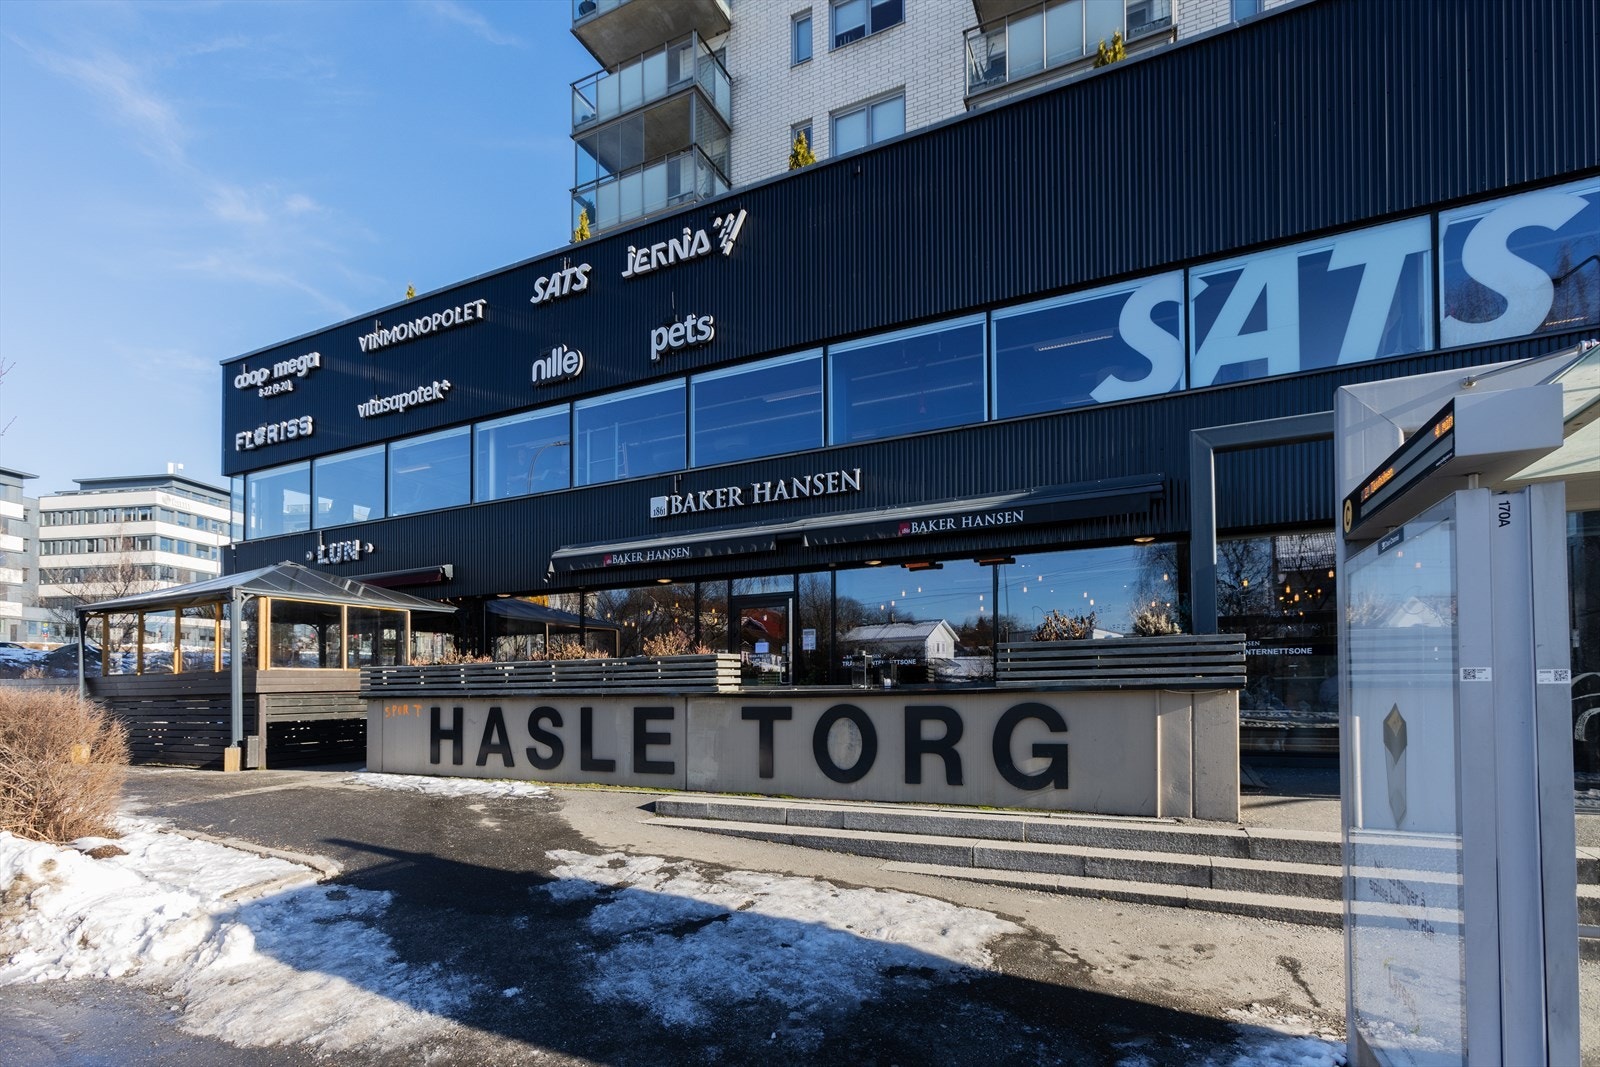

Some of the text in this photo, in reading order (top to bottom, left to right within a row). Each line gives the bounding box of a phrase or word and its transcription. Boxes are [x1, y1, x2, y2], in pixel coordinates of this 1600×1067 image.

[530, 263, 592, 304] SATS
[1089, 191, 1590, 403] SATS
[358, 299, 487, 352] VINMONOPOLET
[651, 313, 715, 362] pets
[234, 352, 321, 390] coop mega
[532, 344, 584, 386] nille
[670, 486, 744, 516] BAKER
[752, 468, 862, 504] HANSEN
[911, 517, 957, 534] BAKER
[961, 510, 1025, 528] HANSEN
[1498, 500, 1511, 528] 170A
[612, 551, 643, 564] BAKER
[647, 546, 690, 561] HANSEN
[1245, 647, 1314, 656] NTERNETTSONE
[430, 702, 1070, 791] HASLE TORG
